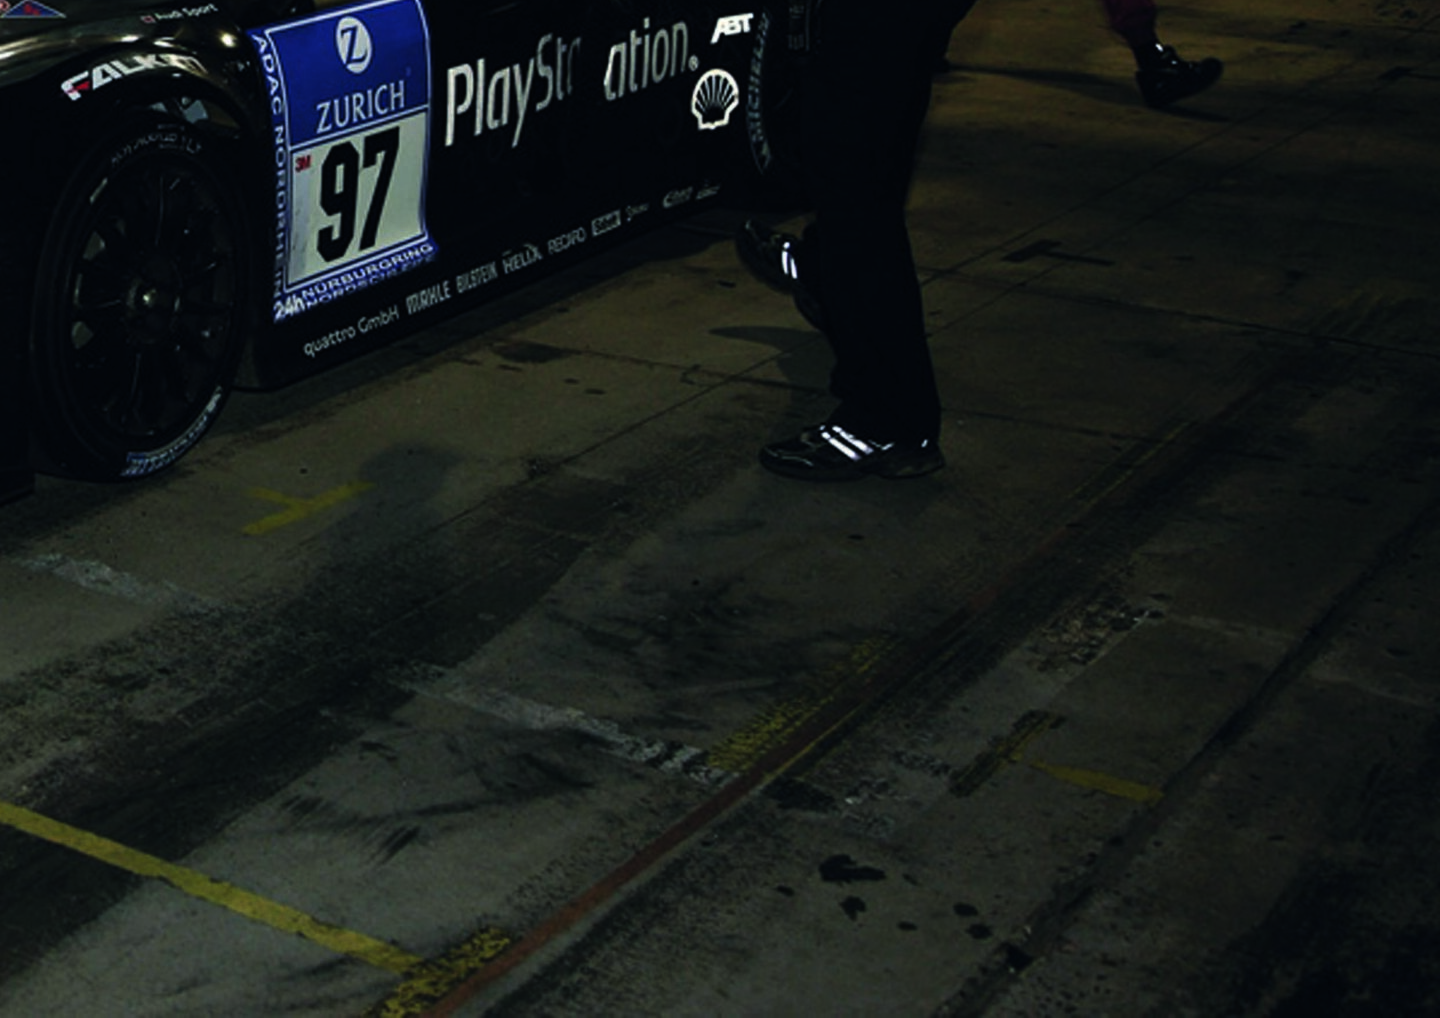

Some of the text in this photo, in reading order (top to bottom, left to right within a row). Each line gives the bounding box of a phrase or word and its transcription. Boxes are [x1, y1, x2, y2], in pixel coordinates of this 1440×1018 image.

[710, 12, 755, 45] ABT
[251, 34, 284, 116] ADAC
[315, 79, 405, 135] ZURICH
[295, 155, 312, 173] 3M
[318, 127, 400, 264] 97
[302, 324, 357, 360] quattro
[357, 304, 400, 335] GmbH
